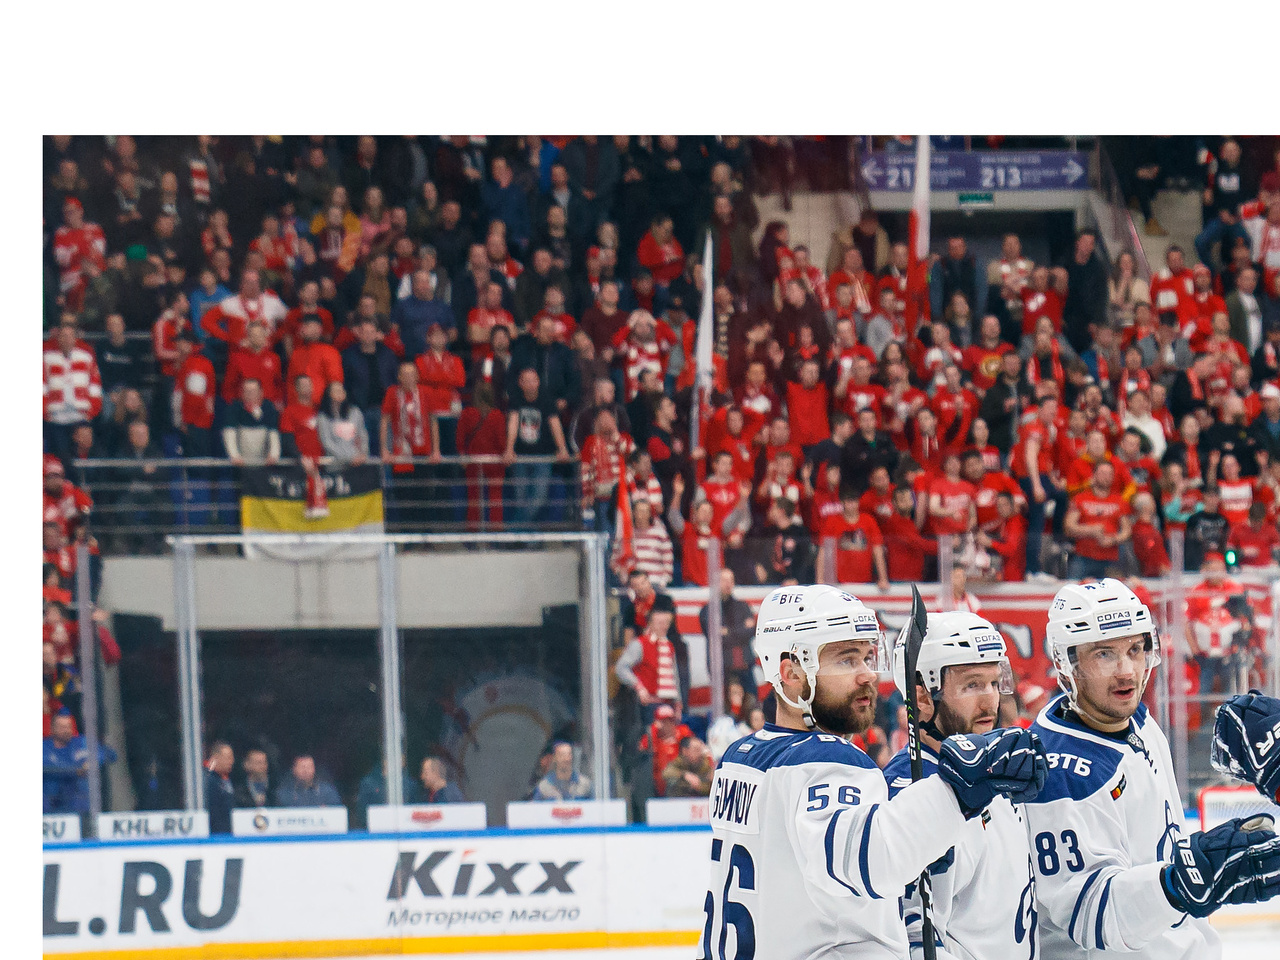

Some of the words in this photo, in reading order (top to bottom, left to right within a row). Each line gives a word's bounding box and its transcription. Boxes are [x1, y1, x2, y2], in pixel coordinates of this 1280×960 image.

[980, 166, 1021, 188] 213
[1097, 611, 1131, 622] СОГАЗ
[908, 724, 917, 760] CCM
[1047, 753, 1092, 776] ВТБ
[807, 783, 861, 812] 56
[112, 815, 193, 837] KHL.RU
[1035, 829, 1085, 876] 83
[386, 850, 583, 901] Kixx
[43, 858, 244, 937] L.RU
[387, 908, 504, 928] Моторное
[510, 907, 580, 922] масло
